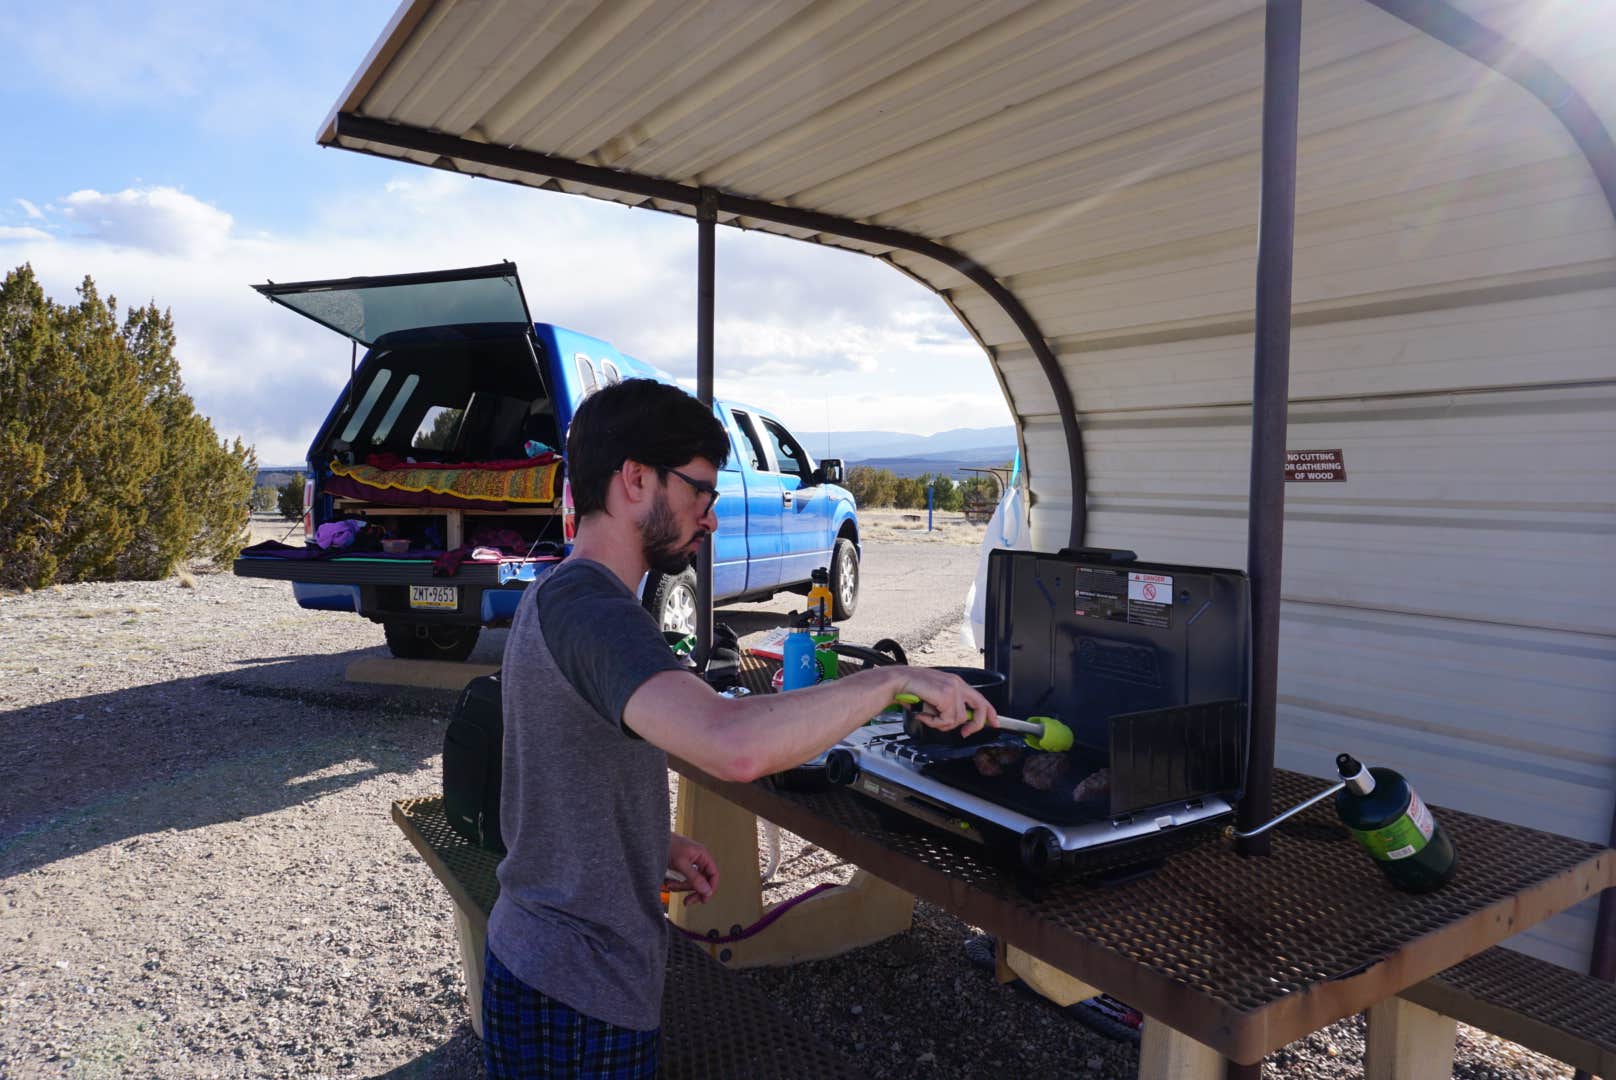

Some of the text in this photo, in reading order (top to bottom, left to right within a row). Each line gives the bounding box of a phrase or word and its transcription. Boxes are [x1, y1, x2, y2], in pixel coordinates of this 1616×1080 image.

[1300, 453, 1335, 461] CUTTING
[1285, 462, 1341, 471] OR GATHERING
[1294, 472, 1334, 480] OF WOOD
